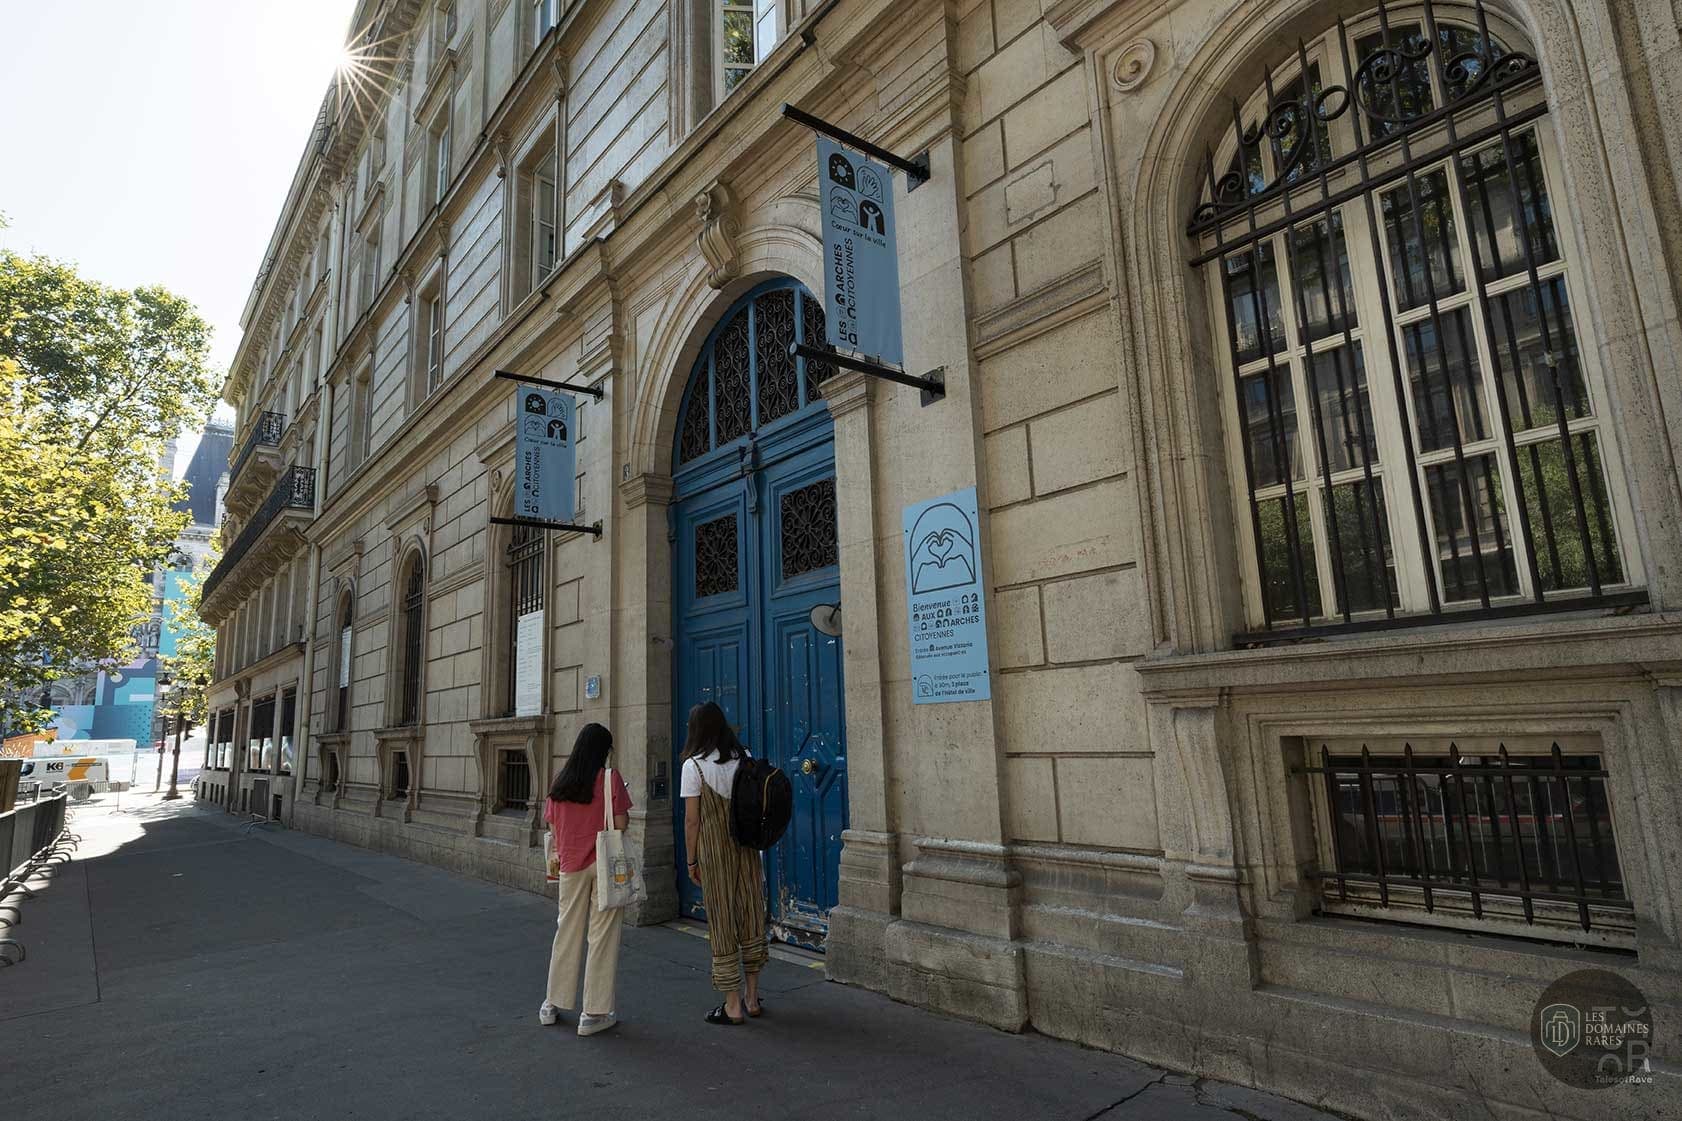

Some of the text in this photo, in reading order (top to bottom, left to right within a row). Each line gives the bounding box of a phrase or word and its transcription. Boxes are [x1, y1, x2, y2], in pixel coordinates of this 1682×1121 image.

[853, 229, 863, 238] sur
[872, 238, 886, 248] ville
[845, 238, 856, 308] CITOYENNES
[834, 243, 847, 341] LES ARCHES
[913, 600, 951, 612] Bienvenue
[922, 612, 936, 621] AUX
[950, 615, 980, 626] ARCHES
[914, 630, 954, 642] CITOYENNES
